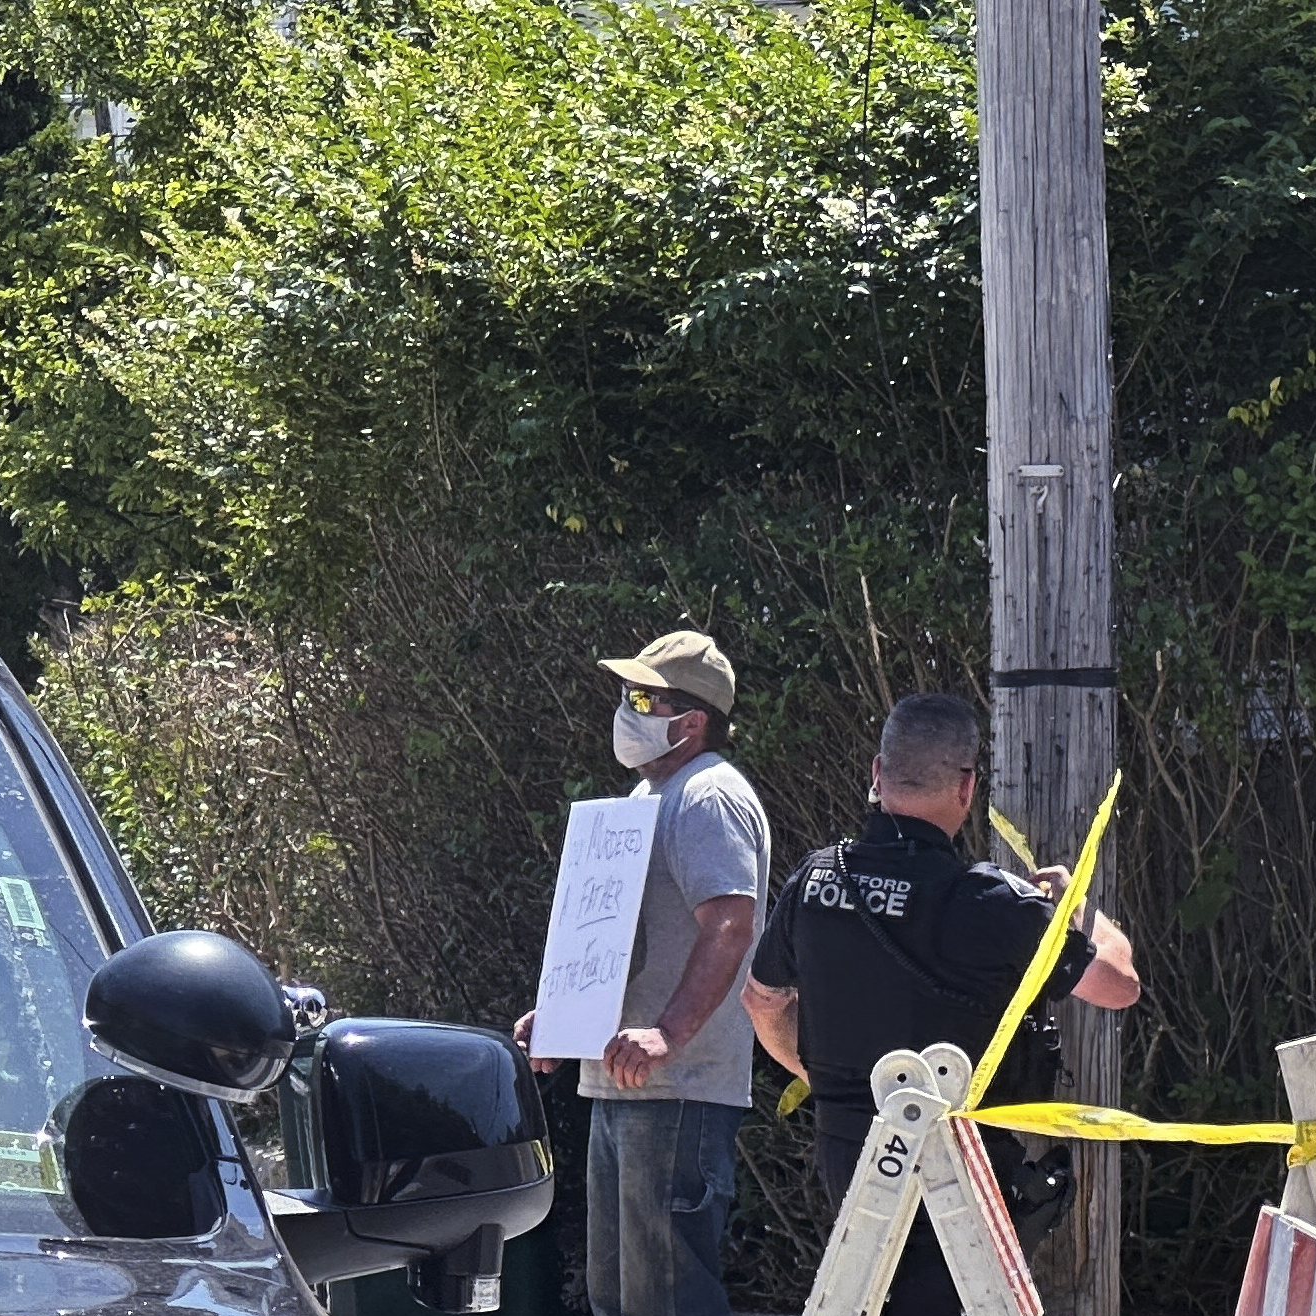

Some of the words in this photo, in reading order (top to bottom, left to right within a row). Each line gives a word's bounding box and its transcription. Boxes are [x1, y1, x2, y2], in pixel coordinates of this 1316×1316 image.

[809, 868, 912, 893] BIDFORD
[600, 949, 628, 984] OUT
[877, 1134, 908, 1178] 40
